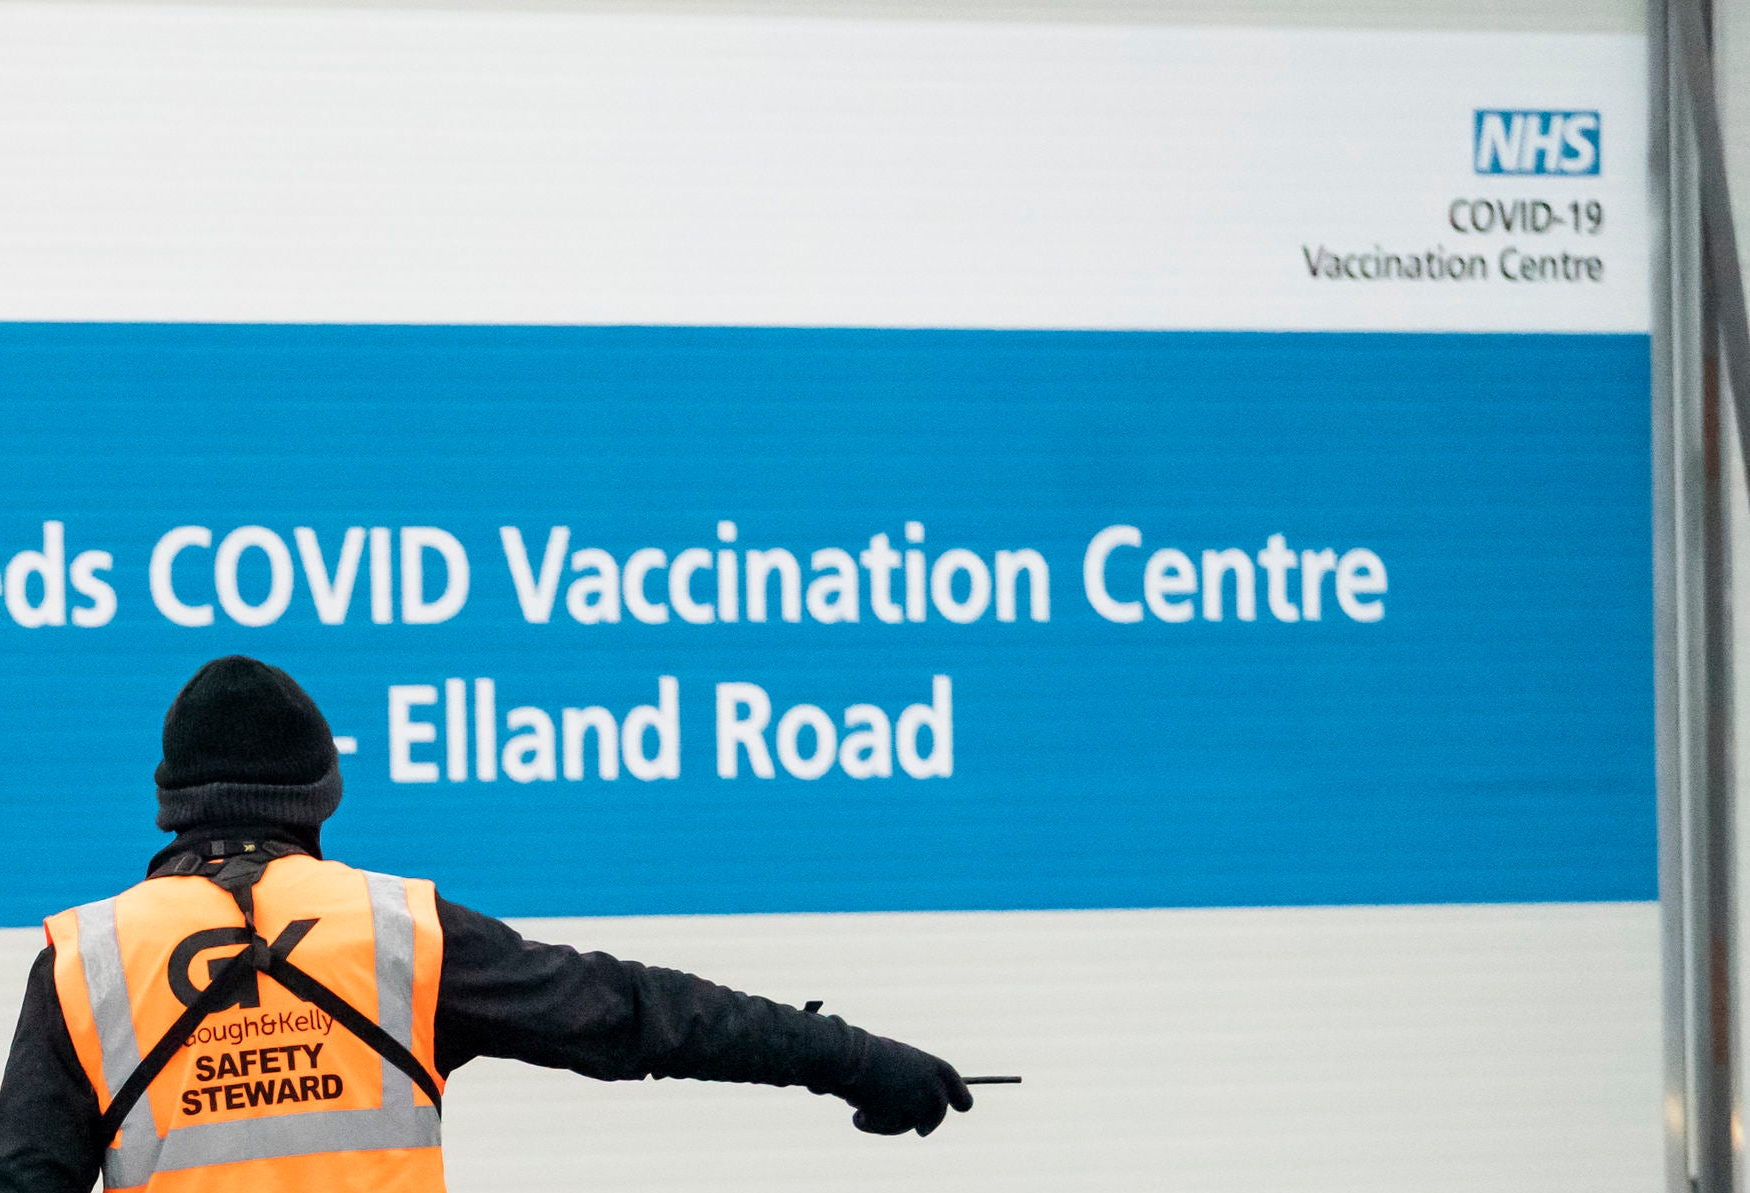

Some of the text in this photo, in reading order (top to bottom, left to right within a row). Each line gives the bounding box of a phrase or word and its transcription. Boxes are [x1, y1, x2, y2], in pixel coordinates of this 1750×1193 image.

[1476, 112, 1598, 173] NHS
[1449, 199, 1604, 234] COVID-19
[1301, 243, 1604, 282] Vaccination Centre
[149, 525, 471, 627] COVID
[500, 520, 1051, 625] Vaccination
[1083, 524, 1389, 624] Centre
[388, 674, 954, 784] Elland Road
[196, 1043, 324, 1082] SAFETY
[181, 1074, 343, 1116] STEWARD
